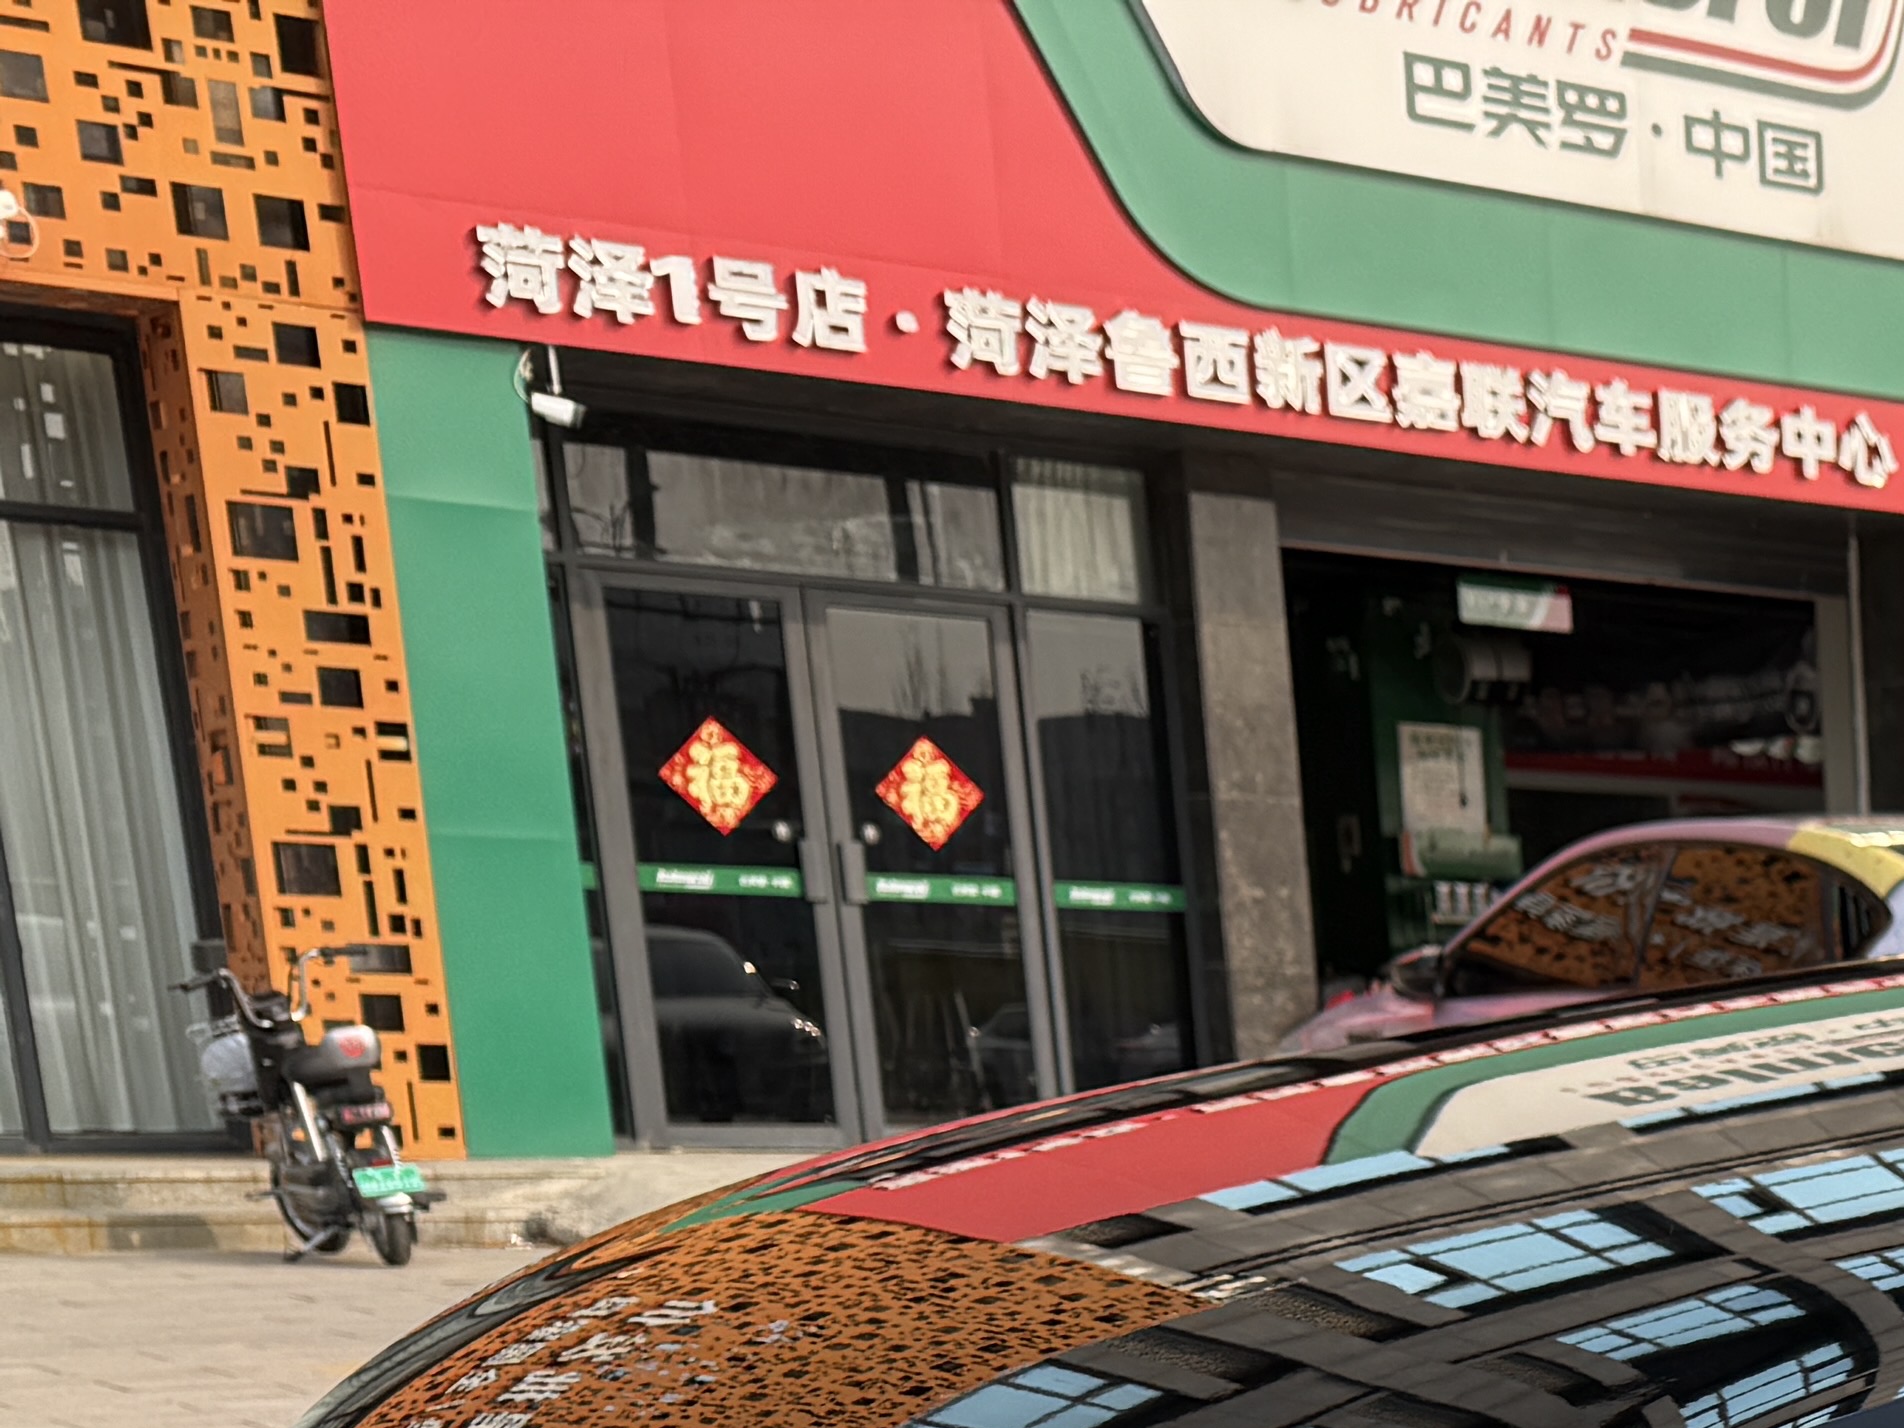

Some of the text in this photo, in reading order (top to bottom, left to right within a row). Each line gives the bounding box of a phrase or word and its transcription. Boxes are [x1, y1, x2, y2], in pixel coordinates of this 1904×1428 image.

[1320, 0, 1617, 62] RICANTS
[1402, 50, 1824, 197] 巴美罗·中国
